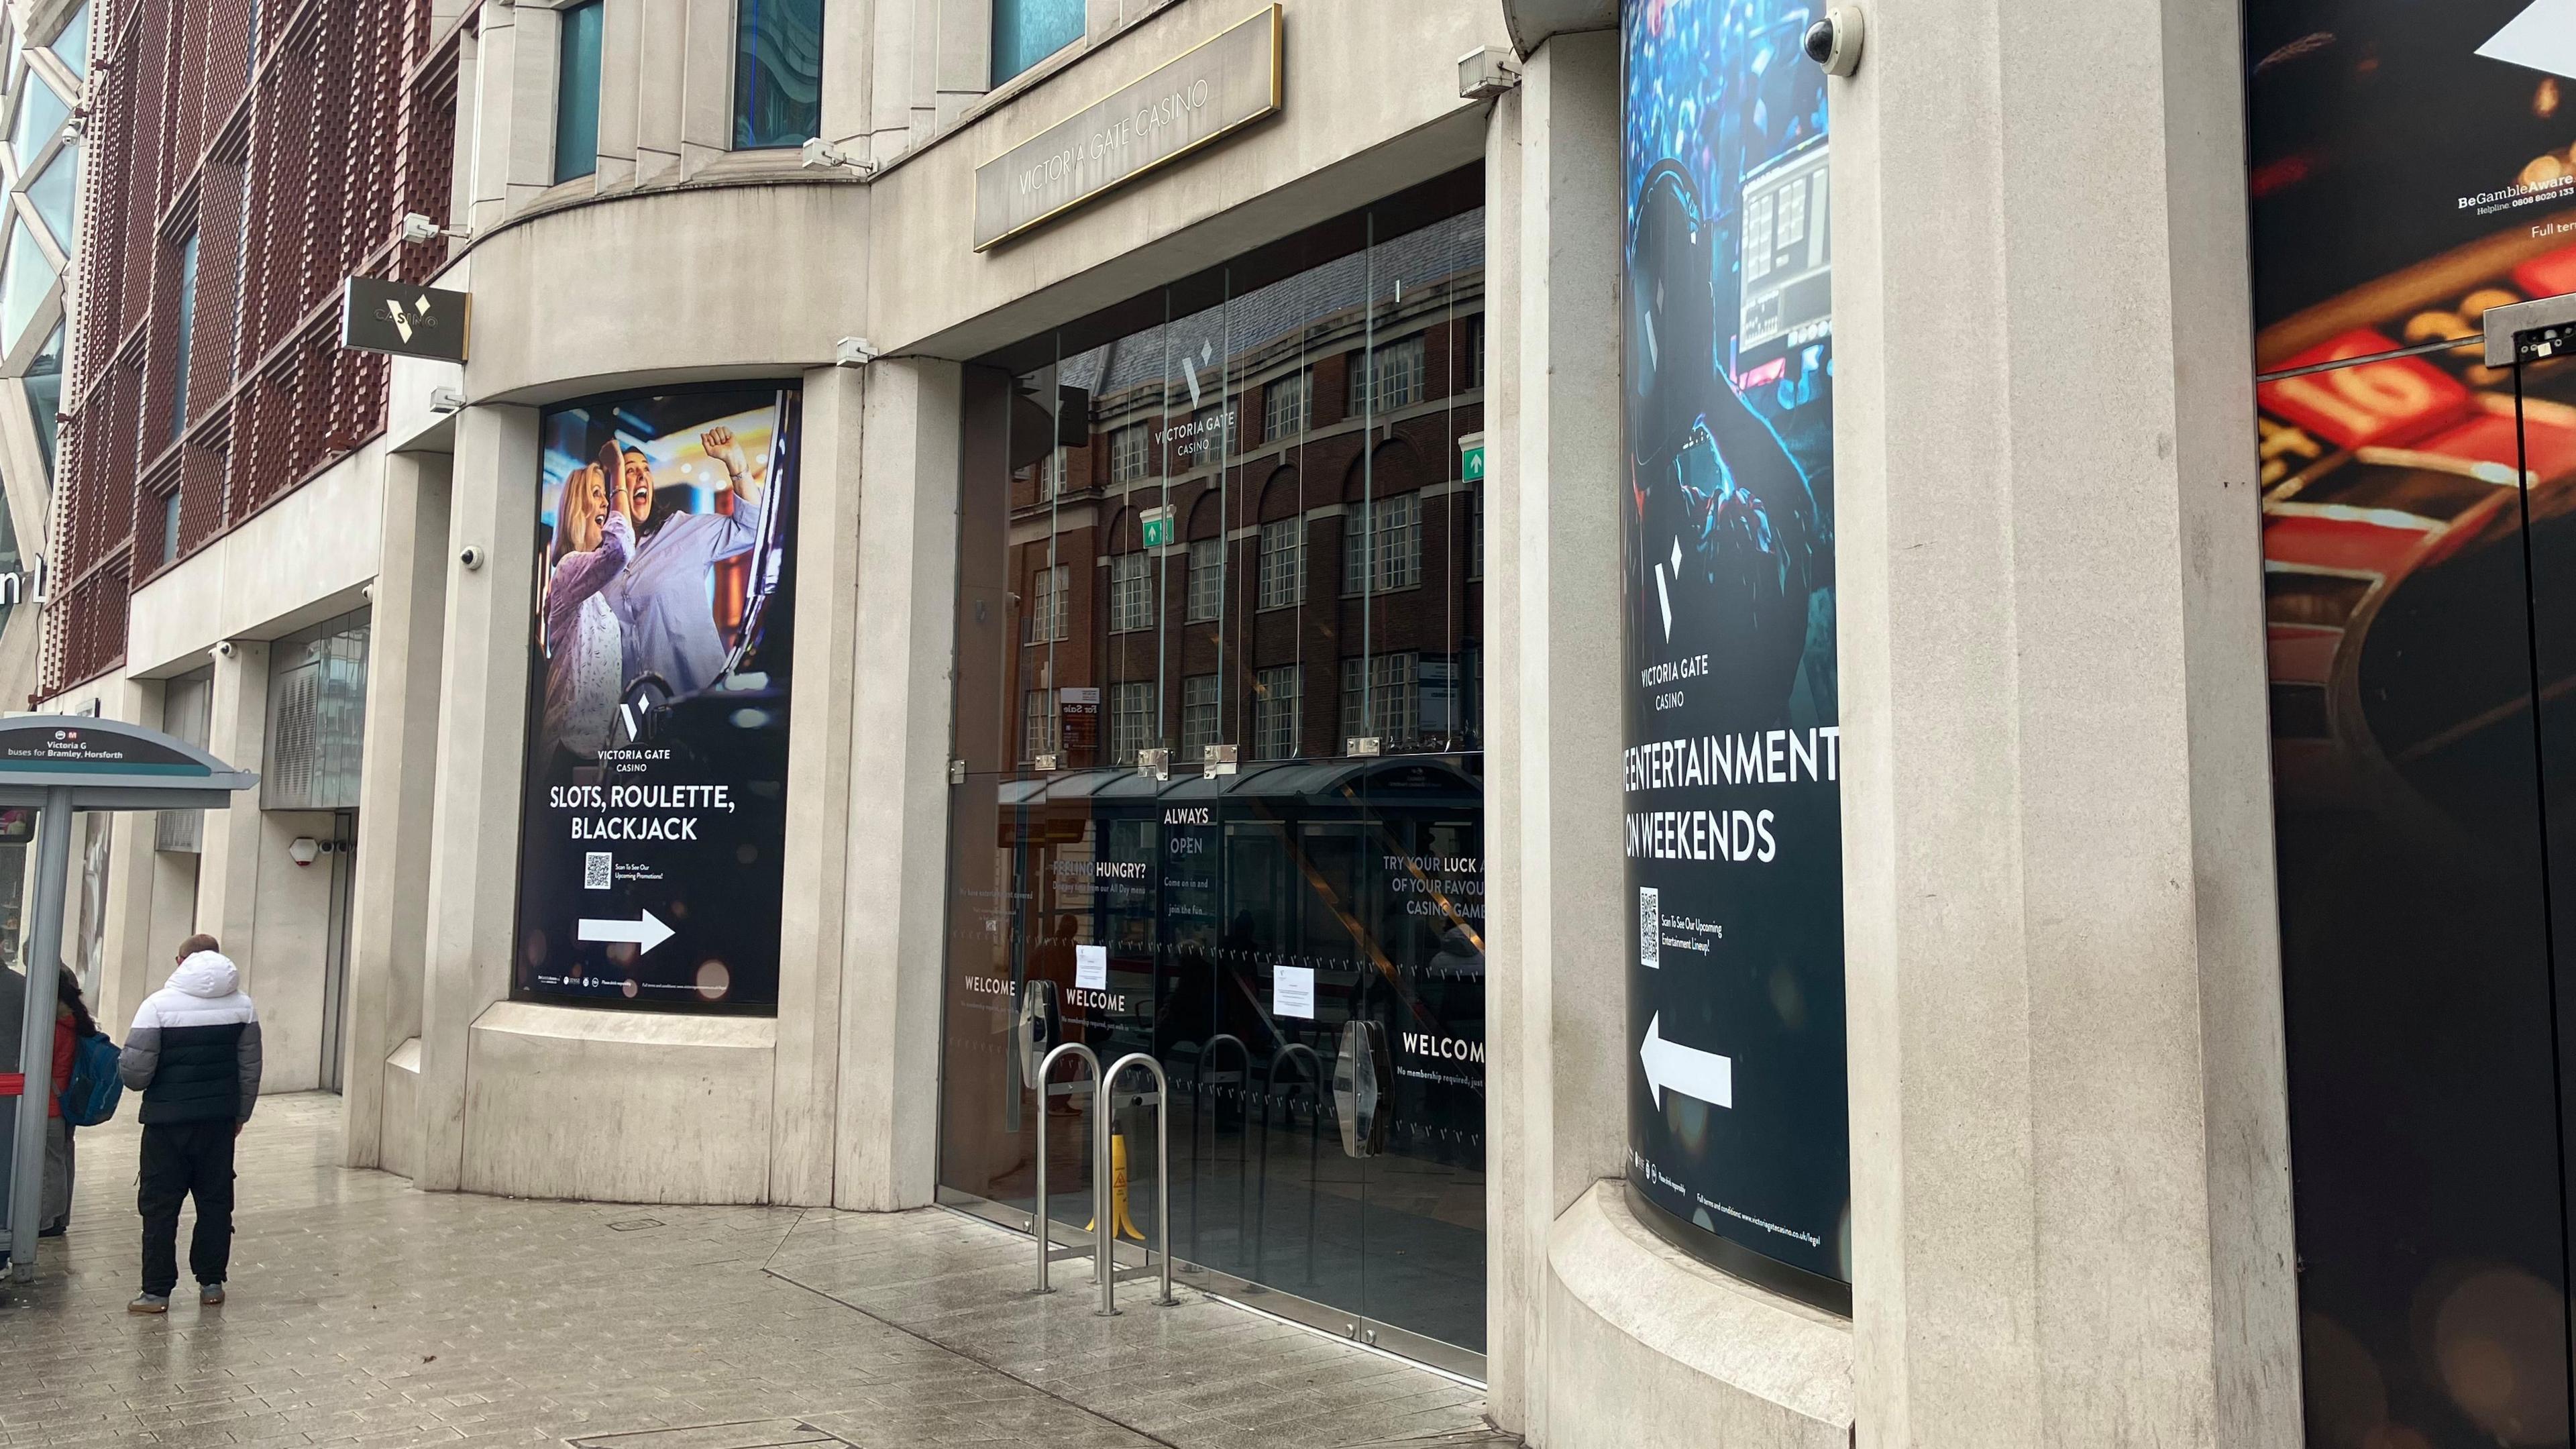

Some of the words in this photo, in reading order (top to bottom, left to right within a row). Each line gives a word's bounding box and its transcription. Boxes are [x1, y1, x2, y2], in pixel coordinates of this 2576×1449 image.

[1020, 144, 1085, 195] VICTORIA
[1090, 118, 1130, 160] GATE
[1136, 79, 1208, 136] CASINO
[2477, 203, 2511, 215] Helpline:
[2512, 197, 2534, 207] 0808
[2535, 191, 2557, 202] 8020
[2559, 186, 2575, 197] 133
[2532, 223, 2553, 238] Full
[2557, 222, 2576, 233] ter
[373, 308, 437, 328] CASINO
[1155, 420, 1204, 445] VICTORIA
[1206, 411, 1234, 431] GATE
[1177, 439, 1210, 456] CASINO
[1641, 658, 1678, 688] VICTORIA
[1680, 654, 1708, 678] GATE
[1655, 690, 1684, 711] CASINO
[8, 748, 32, 756] buses
[48, 749, 83, 759] Bramley,
[85, 751, 123, 759] Horsforth
[598, 750, 643, 761] VICTORIA
[644, 749, 670, 759] GATE
[1630, 726, 1839, 791] ENTERTAINMENT
[616, 764, 647, 772] CASINO
[550, 786, 606, 813] SLOTS,
[610, 786, 735, 813] ROULETTE,
[1164, 808, 1209, 824] ALWAYS
[571, 817, 698, 840] BLACKJACK
[1625, 812, 1639, 857] ON
[1641, 809, 1776, 863] WEEKENDS
[1170, 837, 1203, 854] OPEN
[1053, 861, 1093, 875] FEELING
[1096, 861, 1146, 879] HUNGRY?
[1383, 856, 1404, 870] TRY
[1406, 857, 1440, 871] YOUR
[1444, 857, 1477, 873] LUCK
[1110, 883, 1118, 893] All
[1164, 877, 1181, 887] Come
[1190, 879, 1196, 888] in
[1197, 878, 1208, 888] and
[1392, 877, 1407, 892] OF
[1409, 879, 1442, 893] YOUR
[1169, 903, 1180, 916] join
[1181, 904, 1191, 914] the
[1407, 900, 1450, 916] CASINO
[1662, 914, 1670, 927] Scan
[1670, 915, 1676, 928] To
[1676, 916, 1684, 929] See
[1685, 917, 1695, 930] Our
[1695, 918, 1722, 939] Upcoming
[1662, 932, 1691, 949] Entertainment
[1691, 936, 1710, 957] Lineup!
[965, 975, 1016, 996] WELCOME
[1067, 988, 1125, 1012] WELCOME
[1403, 1032, 1485, 1063] WELCOM
[1397, 1065, 1406, 1075] No
[1407, 1069, 1442, 1083] membership
[1443, 1074, 1470, 1087] required,
[1470, 1077, 1483, 1089] just
